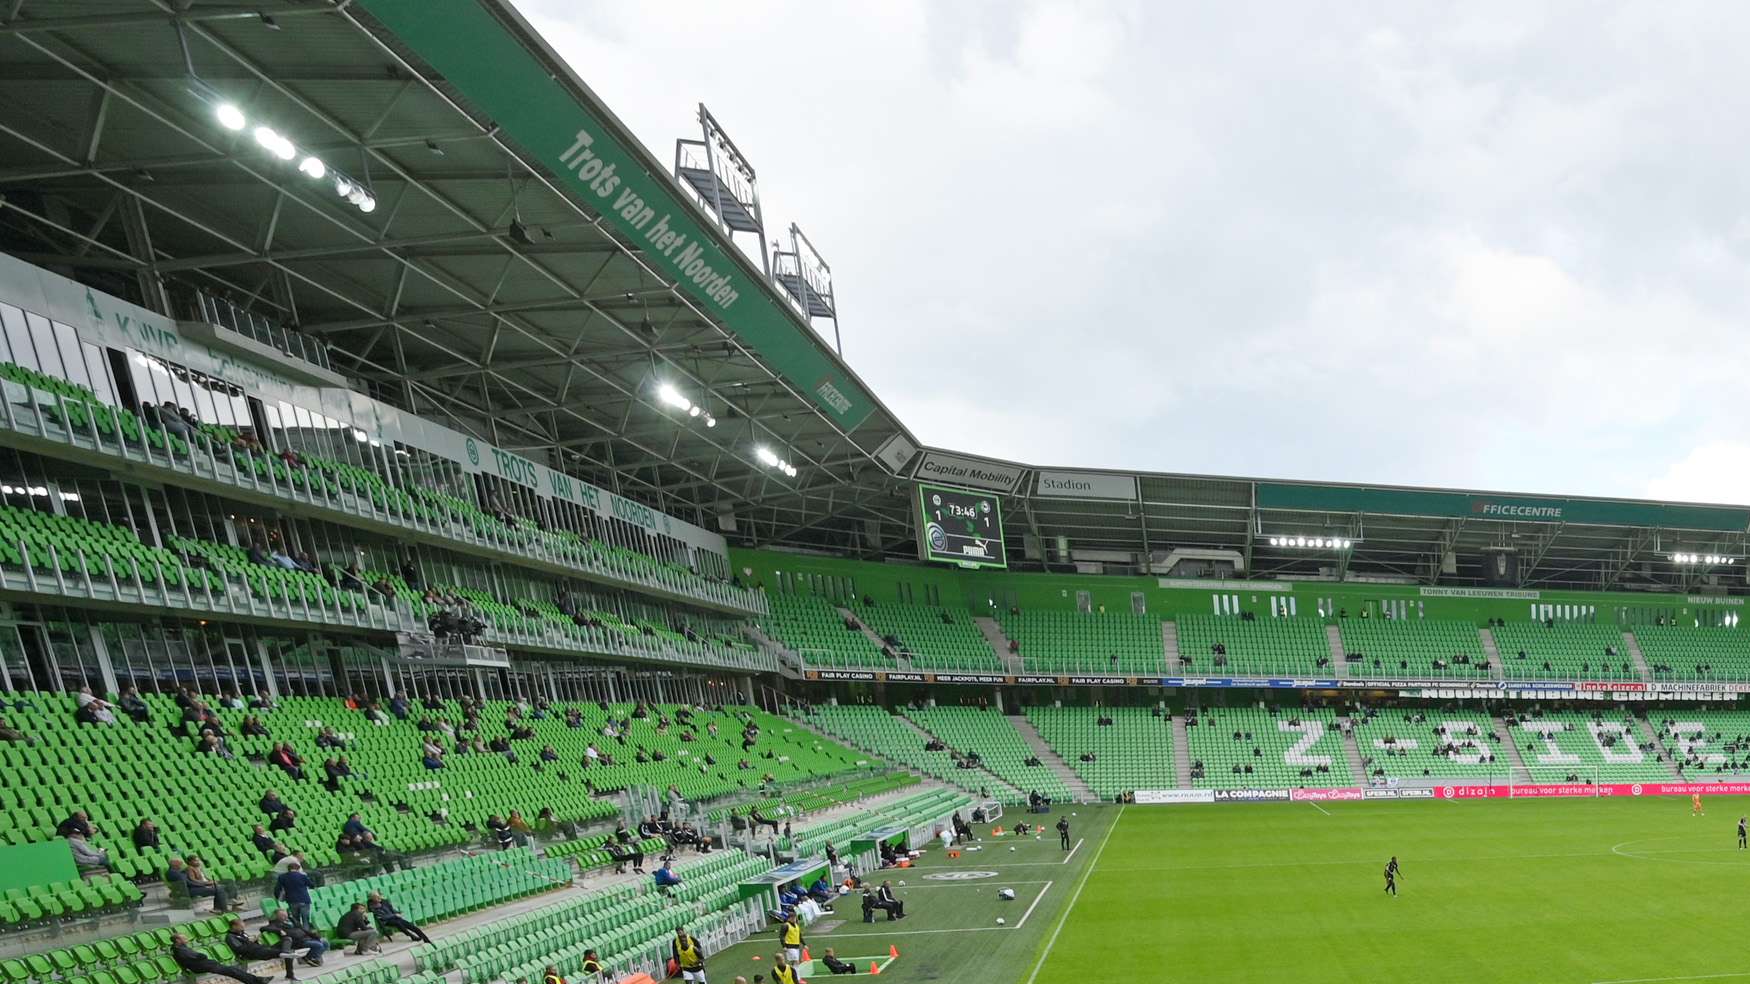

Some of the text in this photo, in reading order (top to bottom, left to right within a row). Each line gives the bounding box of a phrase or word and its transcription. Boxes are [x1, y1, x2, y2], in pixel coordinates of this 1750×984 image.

[559, 129, 739, 309] Trots van het Noorden
[924, 461, 1015, 485] Capital Mobility
[491, 448, 657, 530] TROTS VAN HET NOORDEN
[1043, 479, 1091, 491] Stadion
[935, 510, 941, 520] 1
[949, 504, 975, 517] 73:46
[984, 517, 990, 527] 1
[1688, 596, 1713, 604] NIEUW
[1215, 790, 1289, 798] LA COMPAGNIE
[1584, 787, 1613, 795] meken
